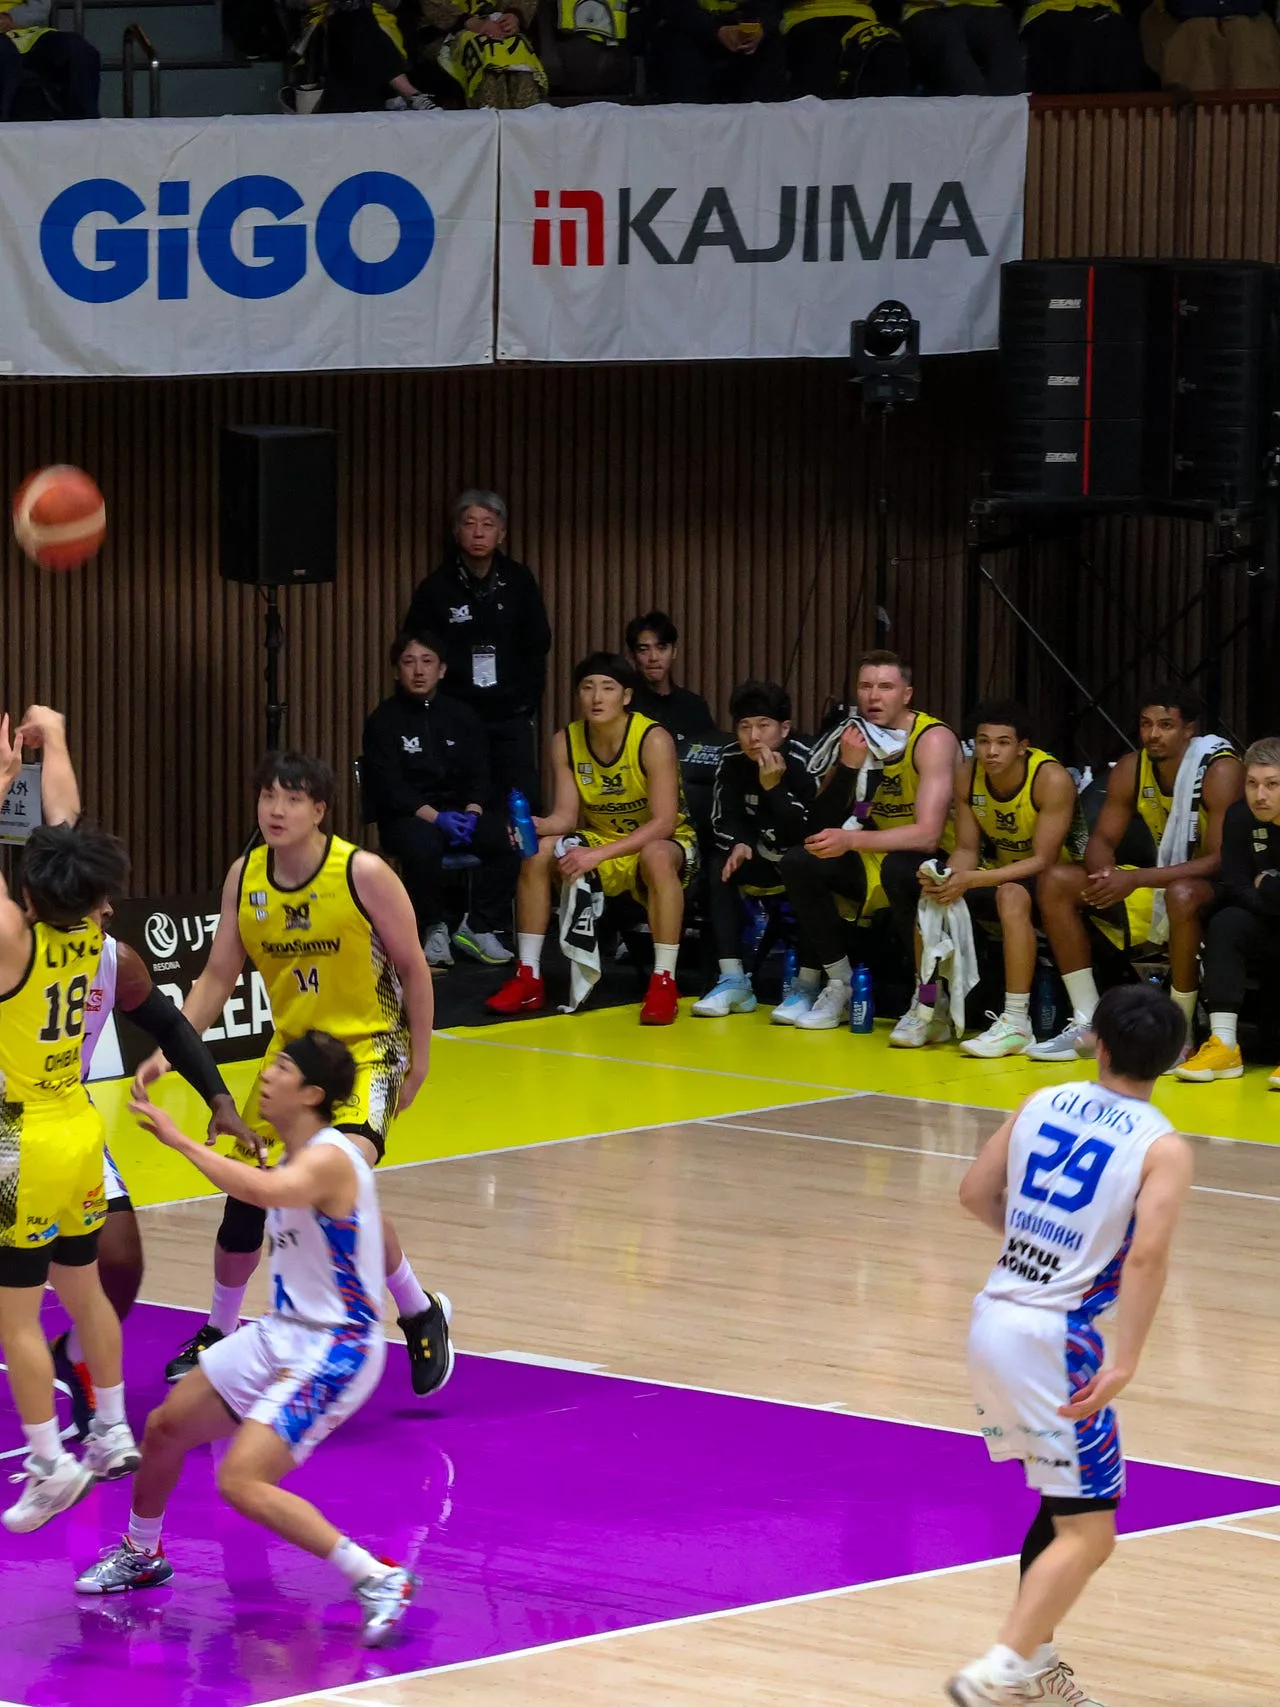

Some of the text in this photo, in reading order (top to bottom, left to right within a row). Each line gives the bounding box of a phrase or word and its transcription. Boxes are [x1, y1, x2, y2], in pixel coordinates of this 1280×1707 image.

[40, 171, 436, 303] GiGO
[618, 181, 989, 265] KAJIMA
[39, 974, 89, 1042] 18
[292, 967, 319, 994] 14
[1051, 1091, 1142, 1136] GLOBIS
[1020, 1122, 1116, 1213] 29
